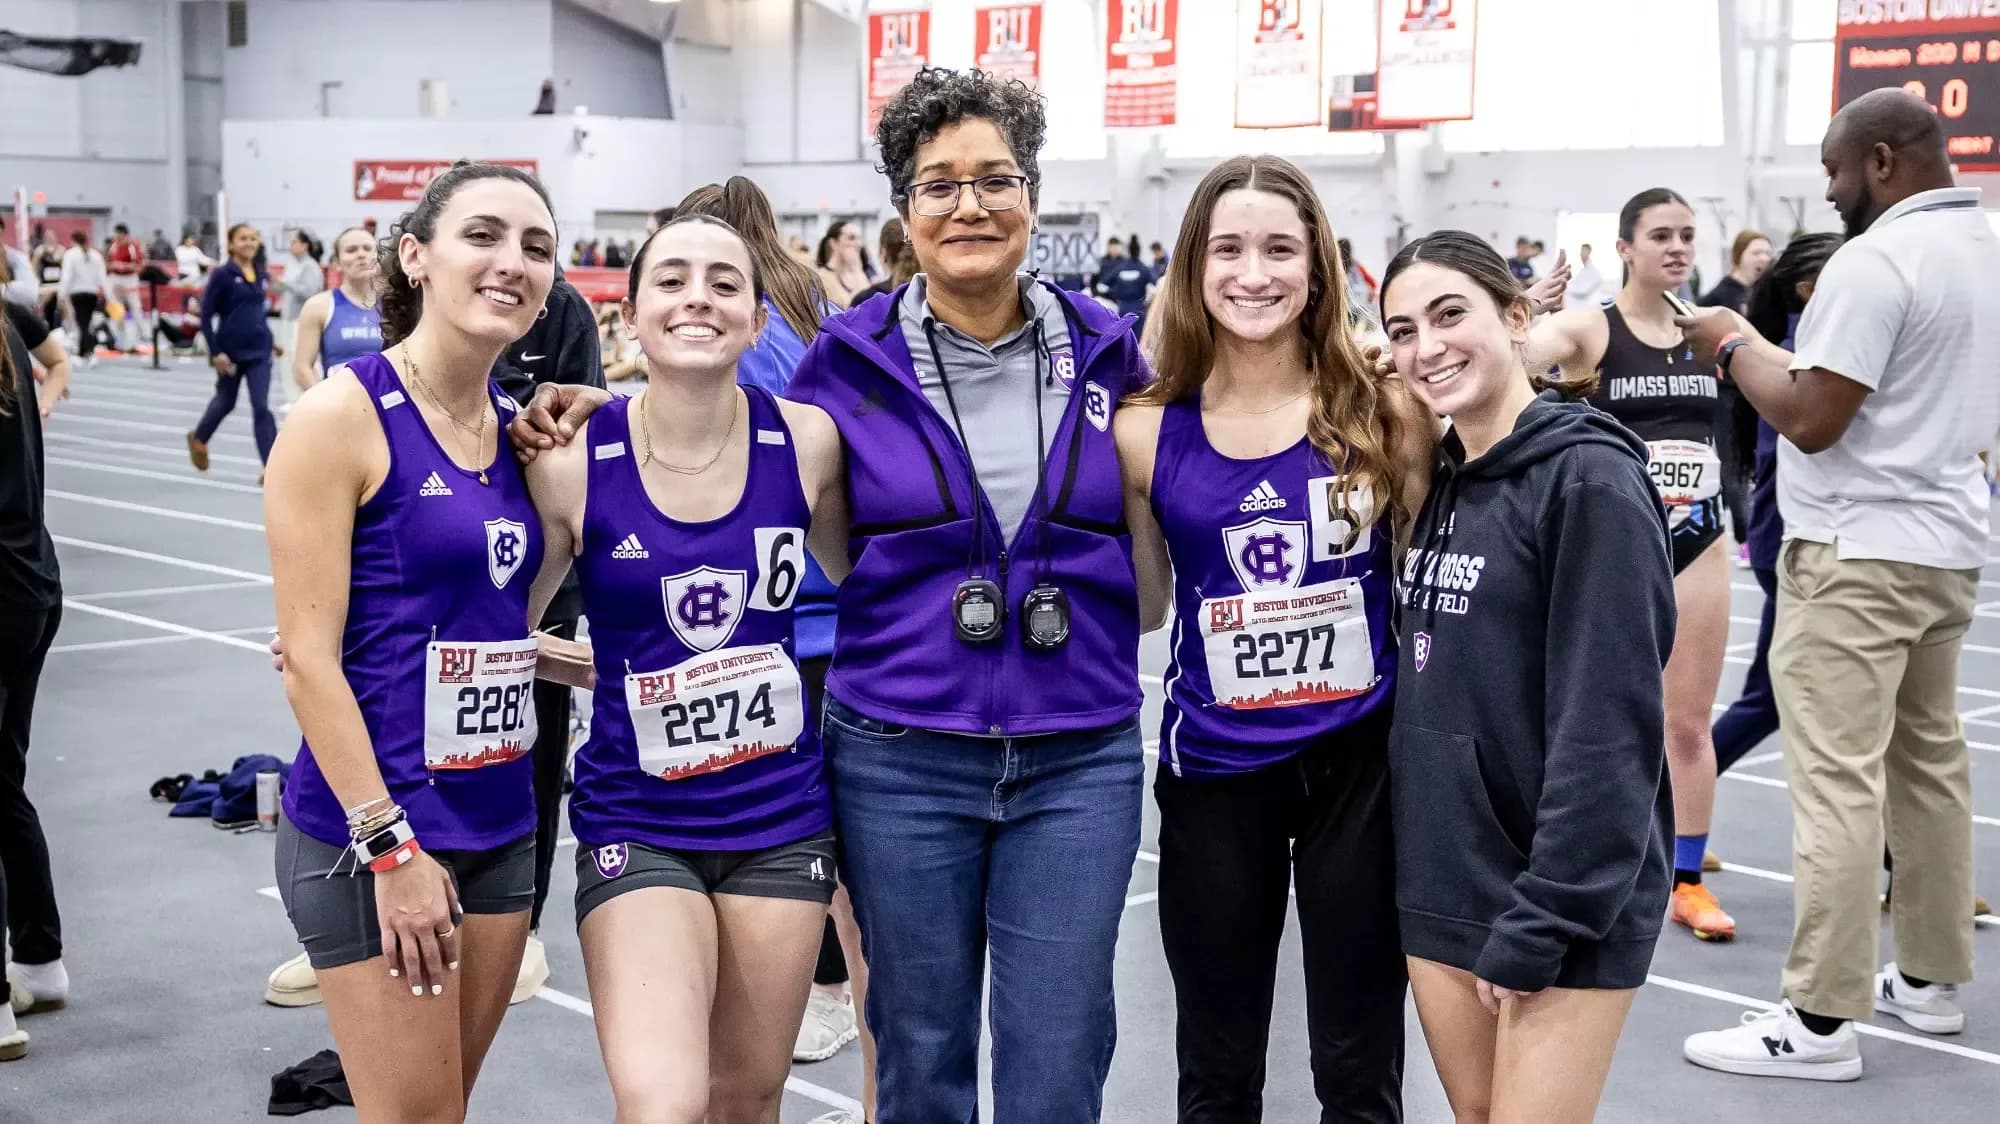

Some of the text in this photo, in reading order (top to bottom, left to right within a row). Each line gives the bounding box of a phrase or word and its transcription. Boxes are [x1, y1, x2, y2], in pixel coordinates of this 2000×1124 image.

[881, 14, 920, 55] BU
[988, 8, 1032, 52] BU
[1610, 375, 1718, 400] UMASS BOSTON
[1650, 462, 1703, 488] 2967
[1239, 498, 1287, 512] adidas
[1326, 482, 1361, 555] 5
[612, 549, 649, 559] adidas
[766, 532, 797, 607] 6
[1210, 599, 1243, 627] BU
[1253, 589, 1348, 612] BOSTON UNIVERSITY
[1435, 593, 1469, 615] FIELD
[439, 648, 477, 677] BU
[485, 652, 514, 663] BOSTON
[1233, 624, 1336, 678] 2277
[685, 651, 775, 681] BOSTON UNIVERSITY
[637, 672, 676, 700] BU
[456, 681, 531, 735] 2287
[661, 681, 776, 748] 2274
